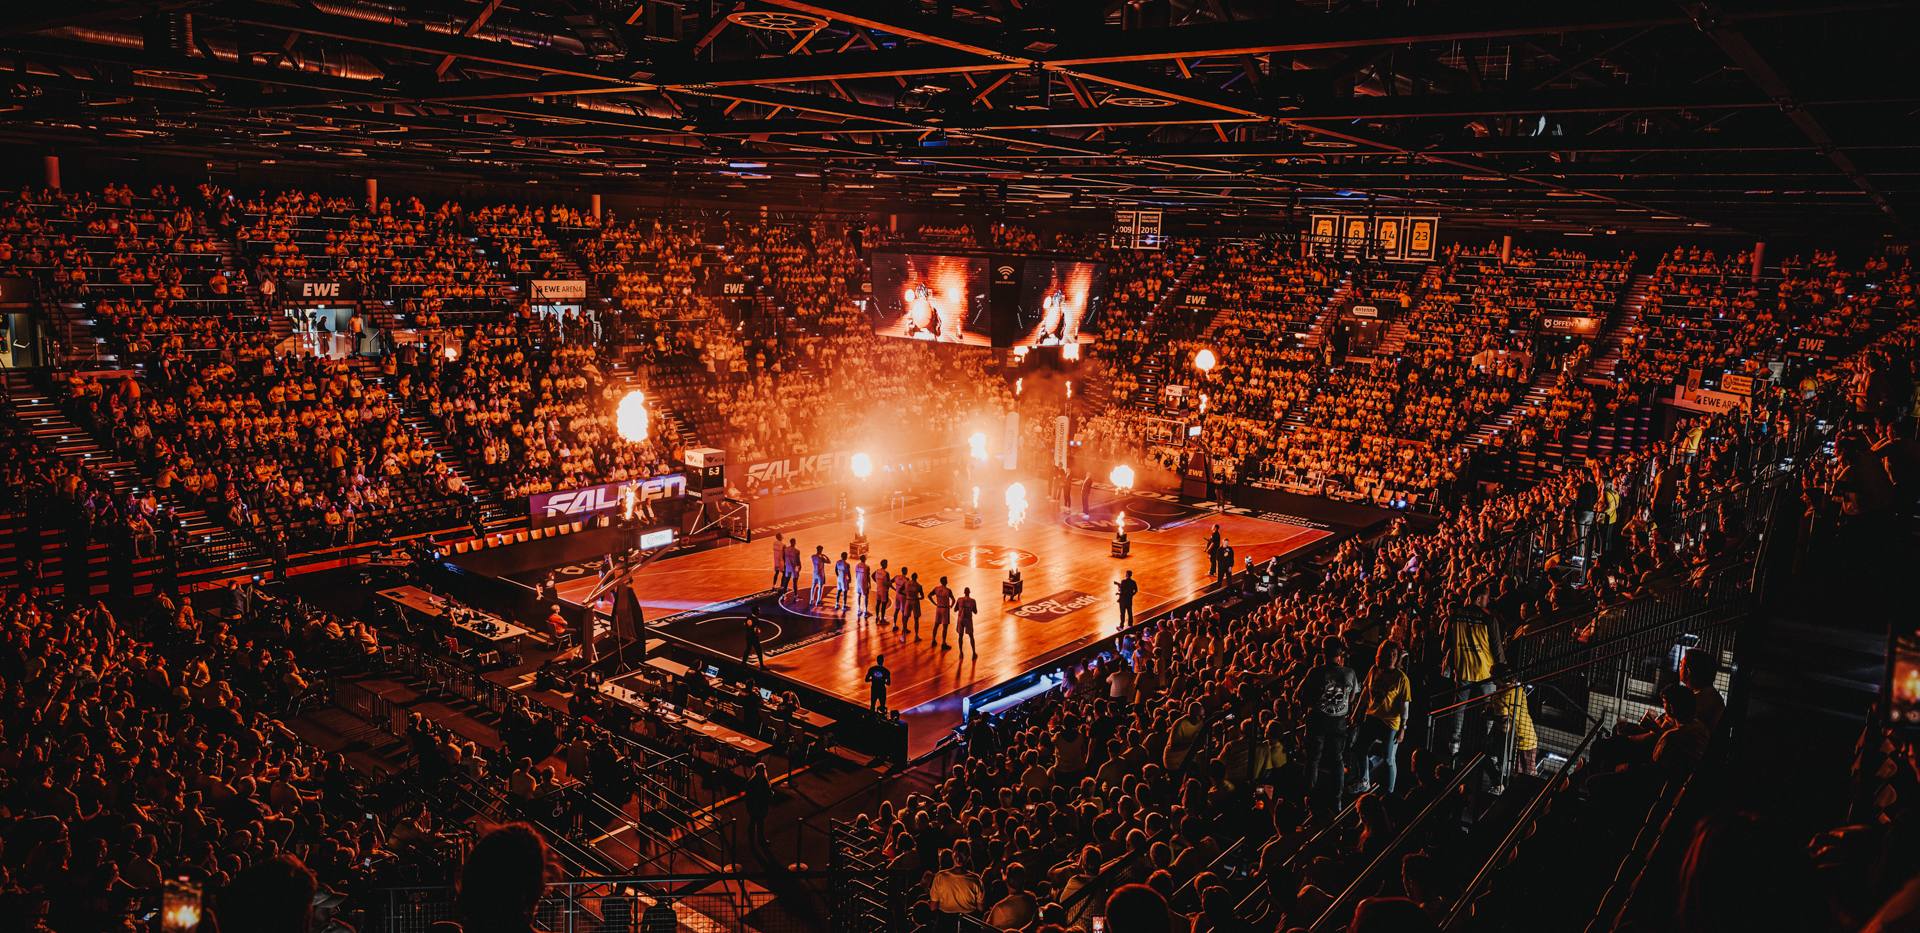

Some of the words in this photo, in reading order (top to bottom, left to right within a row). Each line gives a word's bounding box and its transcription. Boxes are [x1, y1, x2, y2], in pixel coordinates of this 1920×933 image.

[1141, 226, 1158, 234] 2015
[1382, 230, 1395, 239] 14
[1414, 231, 1428, 240] 23
[303, 283, 340, 296] EWE
[723, 283, 745, 294] EWE
[1185, 294, 1207, 305] EWE
[1798, 338, 1825, 351] EWE
[1703, 396, 1721, 408] EWE
[1188, 469, 1204, 478] EWE
[542, 475, 687, 518] FALKEN
